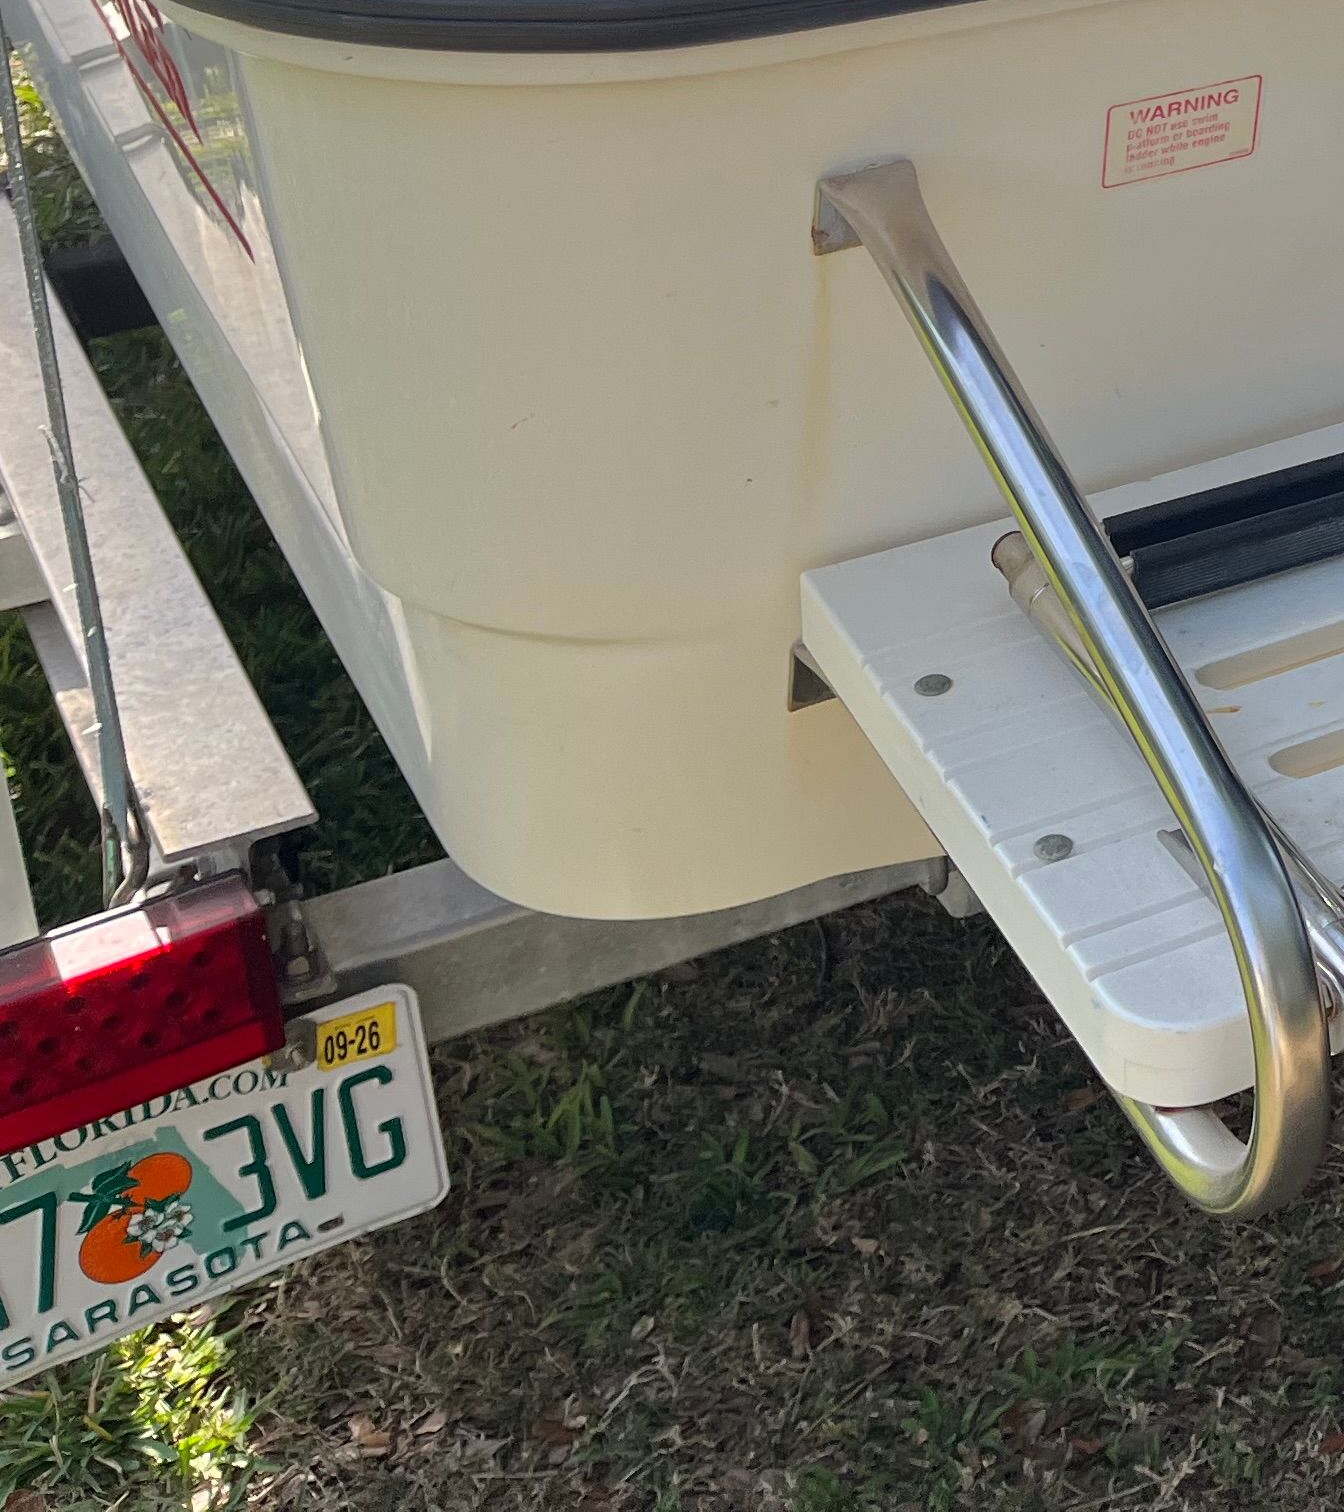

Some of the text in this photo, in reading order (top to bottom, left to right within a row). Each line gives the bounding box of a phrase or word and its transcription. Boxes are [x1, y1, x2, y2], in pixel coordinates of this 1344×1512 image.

[1130, 89, 1239, 124] WARNING
[1146, 122, 1167, 137] NOT
[1170, 119, 1188, 129] use
[1186, 122, 1230, 138] boarding
[1127, 134, 1226, 163] ladder while engine
[324, 1021, 381, 1064] 09-26
[203, 1065, 407, 1233] 3VG
[2, 1220, 311, 1370] SARASOTA
